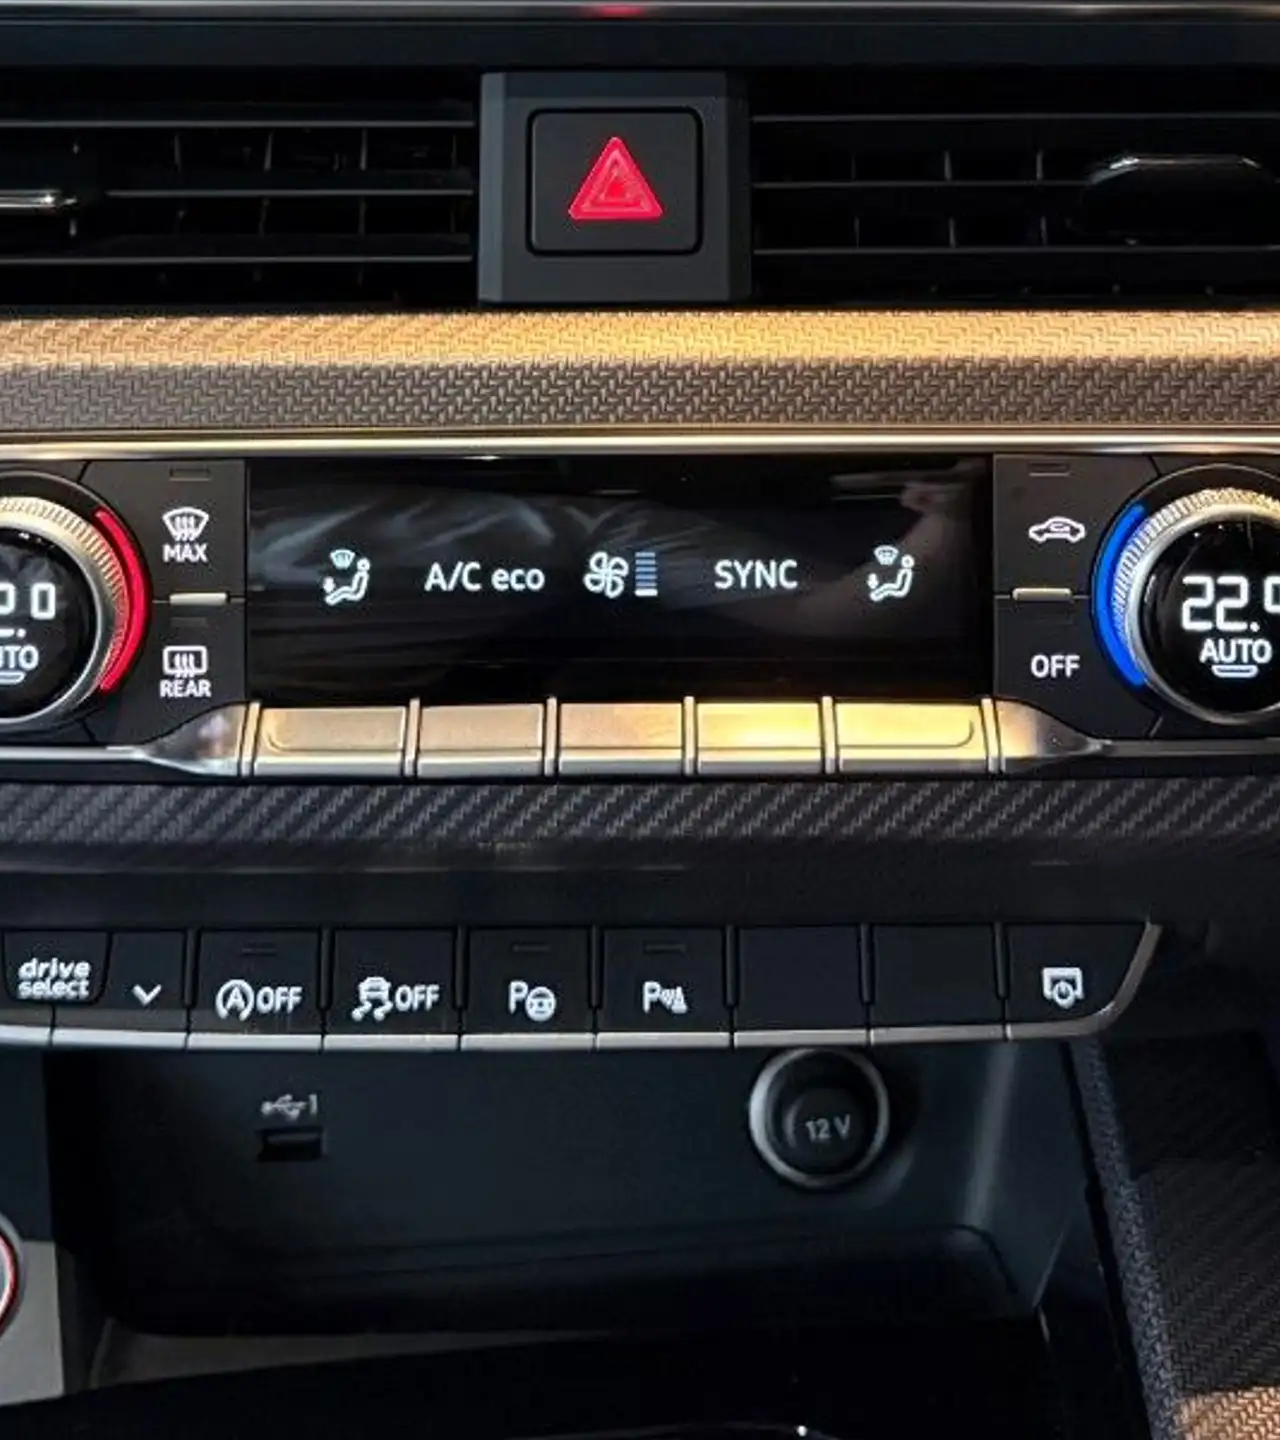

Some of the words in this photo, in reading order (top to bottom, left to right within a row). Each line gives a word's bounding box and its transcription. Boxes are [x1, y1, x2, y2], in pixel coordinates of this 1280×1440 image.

[163, 543, 207, 562] MAX
[424, 561, 482, 591] A/C
[491, 567, 545, 591] eco
[714, 560, 798, 589] SYNC
[1199, 638, 1272, 664] AUTO
[1030, 654, 1080, 678] OFF
[159, 679, 212, 698] REAR
[18, 957, 90, 979] drive
[18, 976, 89, 1000] select
[256, 985, 303, 1014] OFF
[394, 984, 440, 1011] OFF
